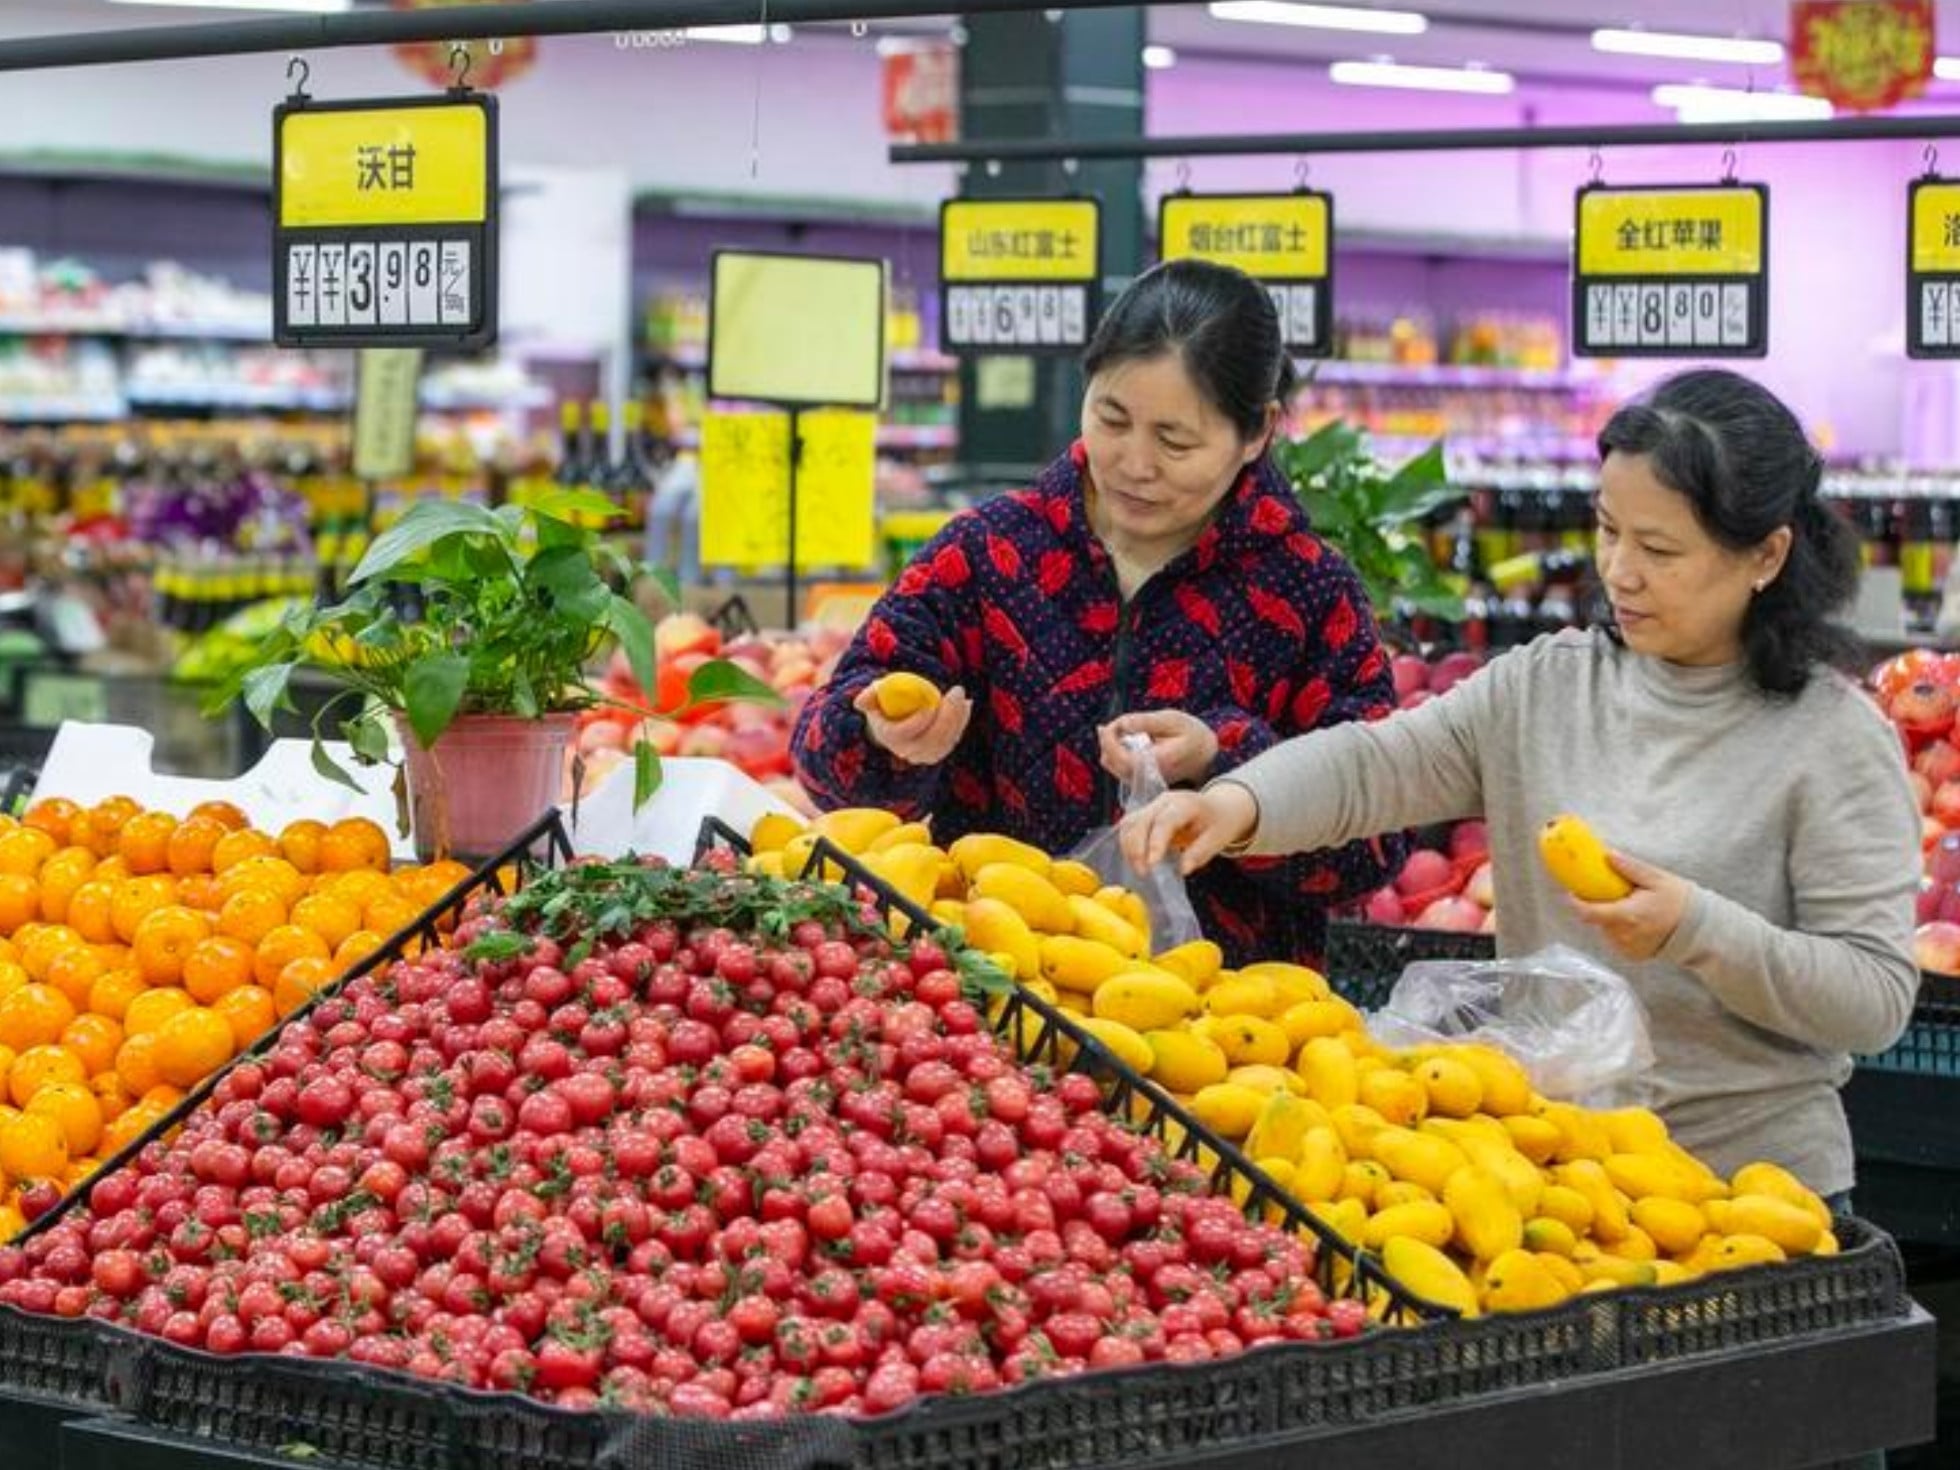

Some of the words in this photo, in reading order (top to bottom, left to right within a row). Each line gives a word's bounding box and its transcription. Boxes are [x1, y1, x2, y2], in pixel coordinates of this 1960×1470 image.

[357, 144, 416, 192] 沃甘
[968, 229, 1080, 260] 山东红富士
[1189, 221, 1308, 254] 烟台红富士
[1616, 218, 1722, 251] 全红苹果
